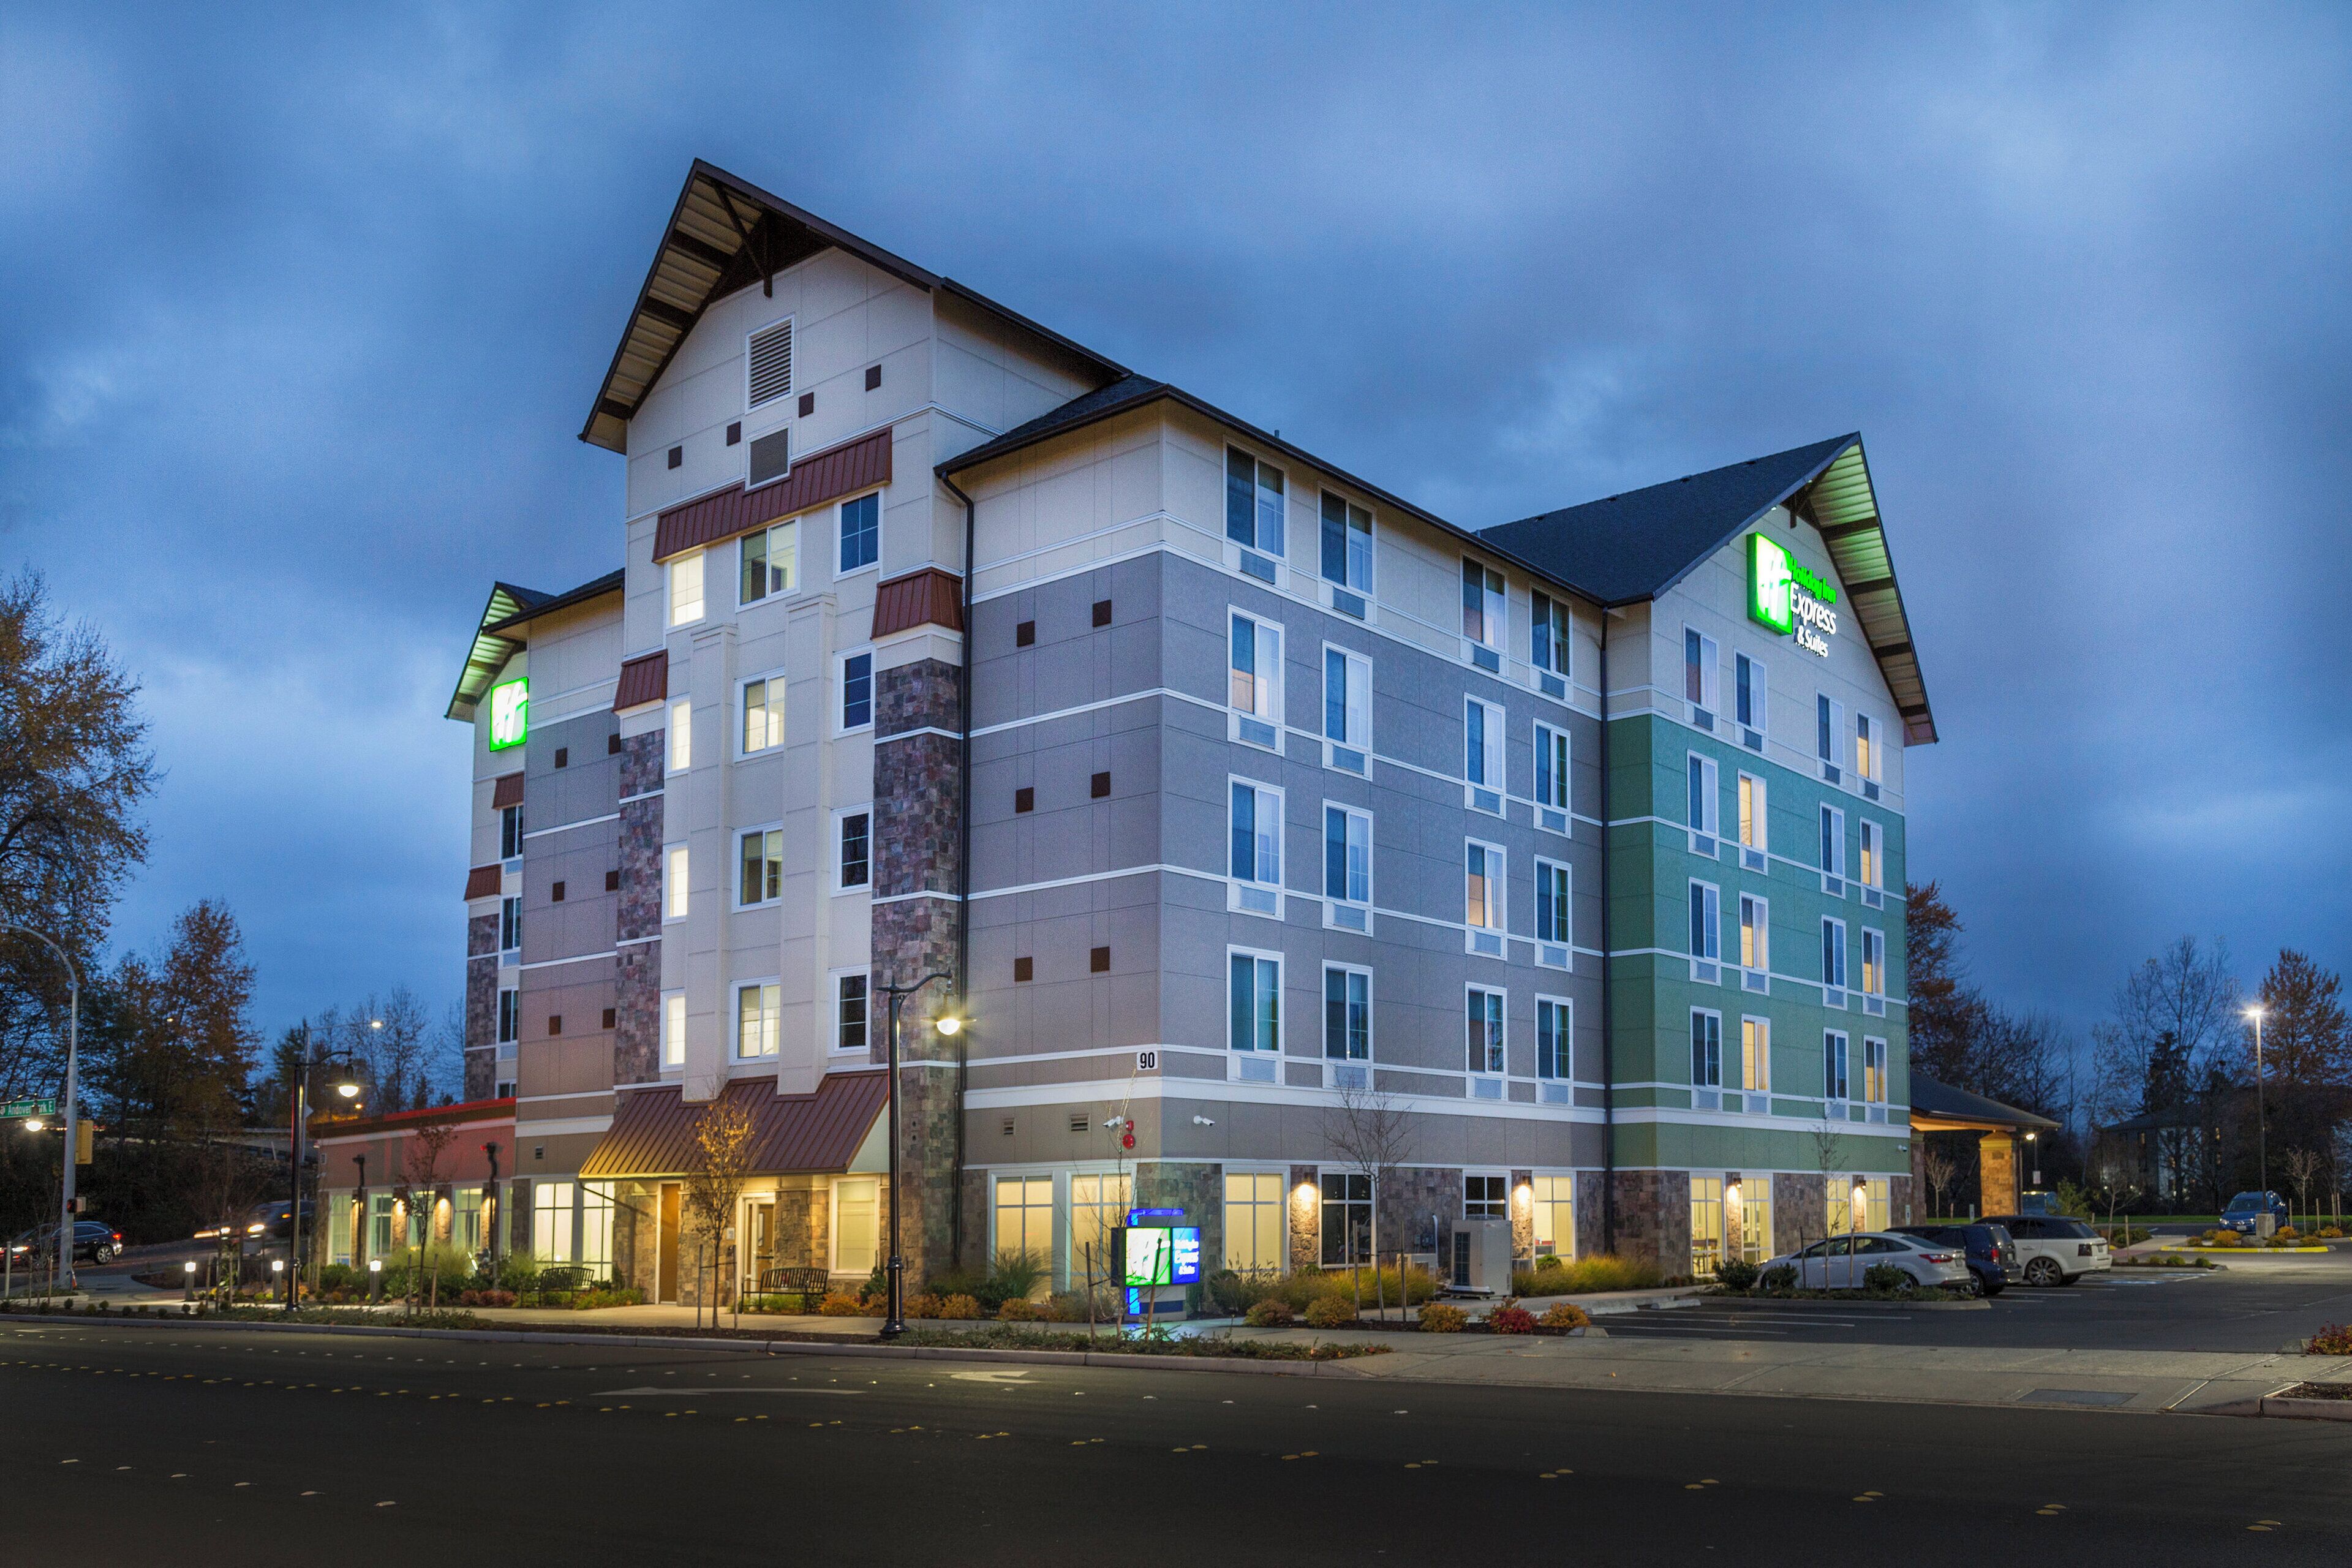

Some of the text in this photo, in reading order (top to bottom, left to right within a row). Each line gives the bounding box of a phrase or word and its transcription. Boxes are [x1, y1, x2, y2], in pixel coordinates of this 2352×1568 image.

[1790, 557, 1836, 605] Holiday Inn
[1790, 582, 1837, 635] Express
[1797, 625, 1828, 657] & Suites
[1140, 1052, 1155, 1069] 90
[49, 1101, 53, 1112] E
